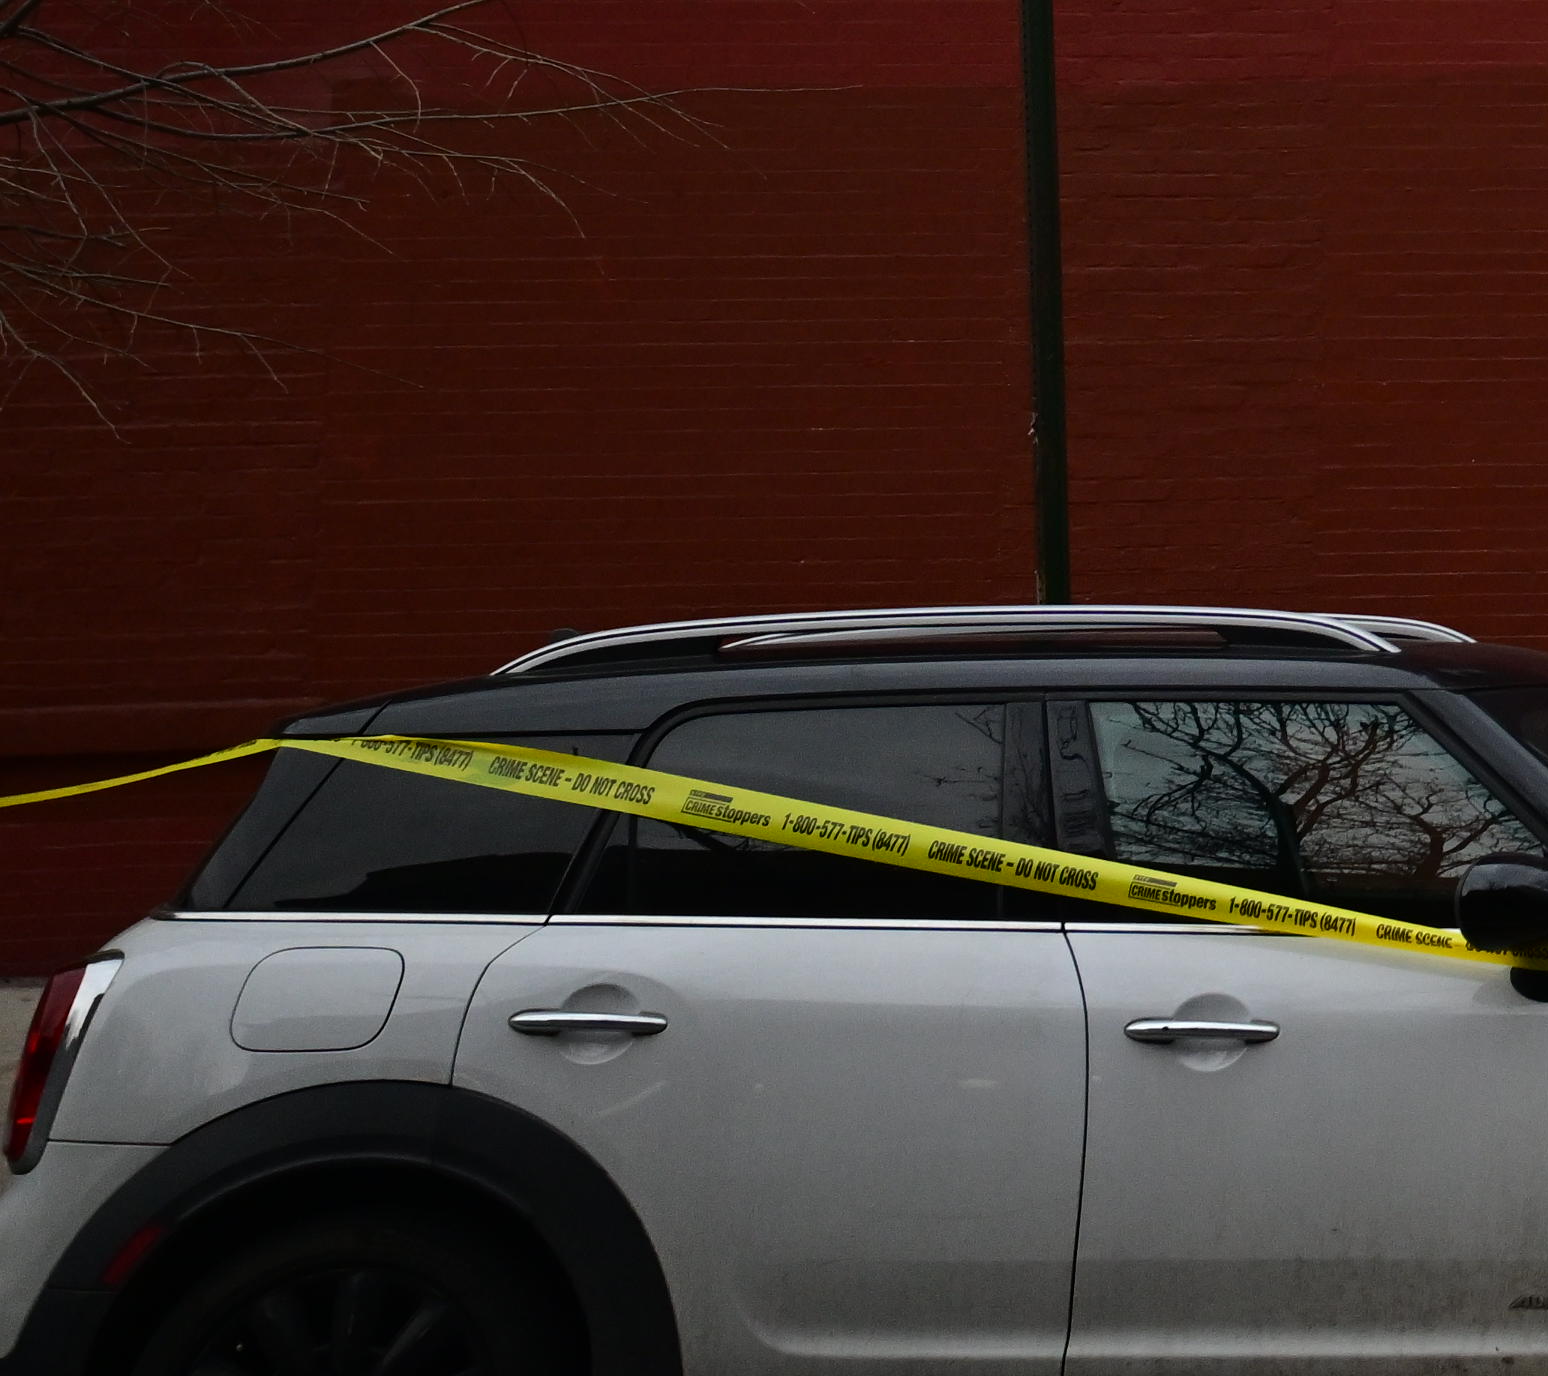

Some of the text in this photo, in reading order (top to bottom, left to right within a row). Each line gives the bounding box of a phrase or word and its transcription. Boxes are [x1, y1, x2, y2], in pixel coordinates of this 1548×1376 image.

[488, 756, 526, 781] CRIME
[525, 761, 563, 787] SCENE
[571, 772, 592, 793] DO
[589, 774, 616, 799] NOT
[613, 778, 655, 805] CROSS
[781, 812, 910, 856] 1-800-577-TIPS (8477)
[927, 839, 966, 865] CRIME
[964, 846, 1004, 872] SCENE
[1014, 857, 1035, 879] DO
[1032, 860, 1060, 884] NOT
[1057, 864, 1098, 891] CROSS
[1228, 896, 1355, 936] 1-800-577-TIPS (8477)
[1375, 923, 1412, 944] CRIME
[1414, 931, 1452, 949] SCENE
